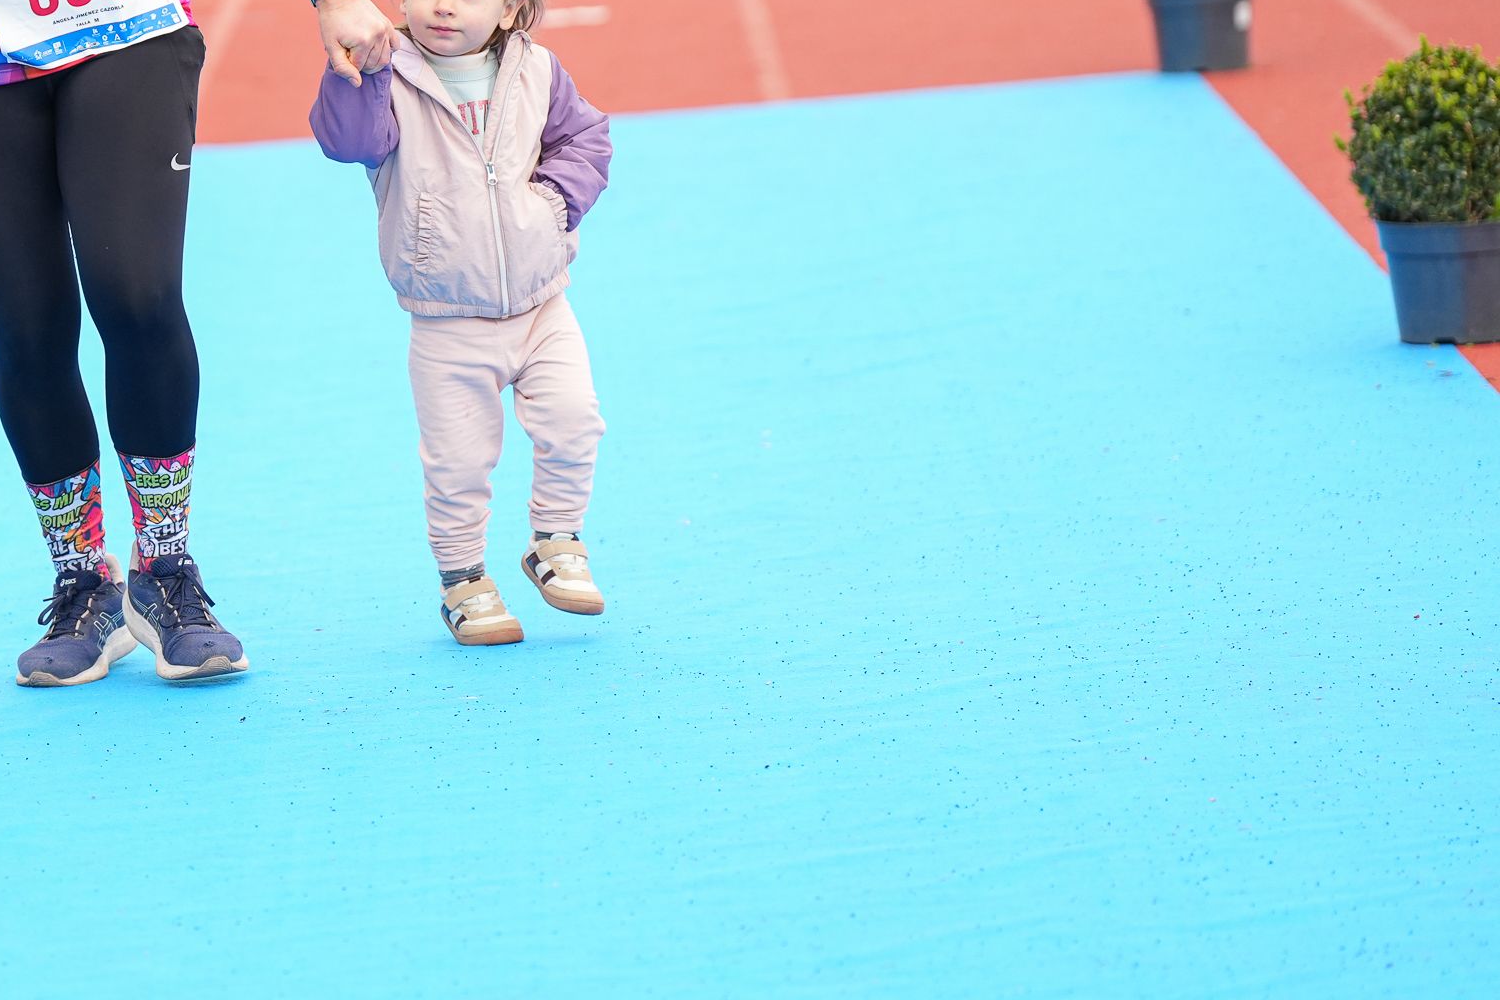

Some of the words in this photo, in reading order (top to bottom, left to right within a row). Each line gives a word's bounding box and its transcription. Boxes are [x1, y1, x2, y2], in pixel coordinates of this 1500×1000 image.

[136, 475, 170, 488] ERES
[173, 465, 190, 485] MI
[33, 497, 51, 511] ES
[53, 491, 74, 510] MI
[139, 482, 190, 508] HEROINA
[48, 541, 67, 556] HE
[160, 536, 186, 556] BES
